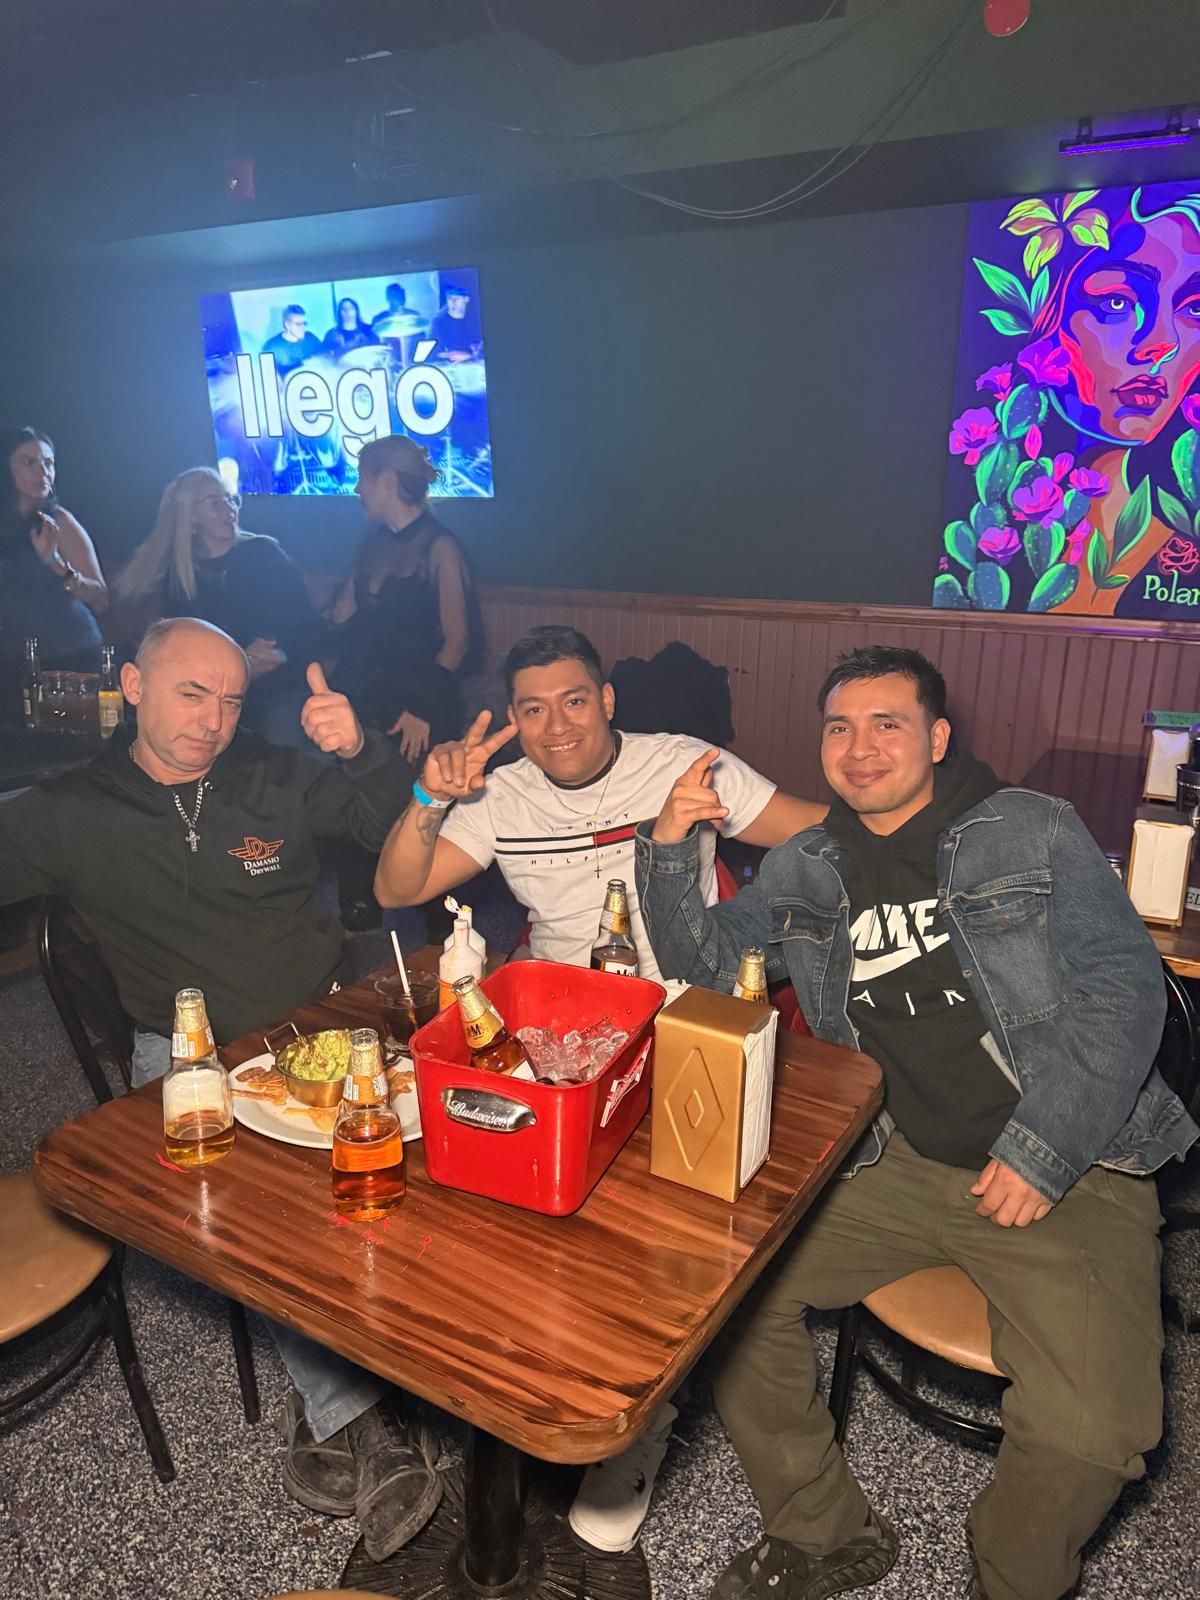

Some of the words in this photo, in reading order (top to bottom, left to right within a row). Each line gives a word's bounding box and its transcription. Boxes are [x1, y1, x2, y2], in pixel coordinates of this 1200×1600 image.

[236, 339, 454, 457] llegó
[243, 856, 280, 871] DAMASIO
[849, 898, 951, 954] NIKE
[451, 1100, 509, 1127] Budweiser
